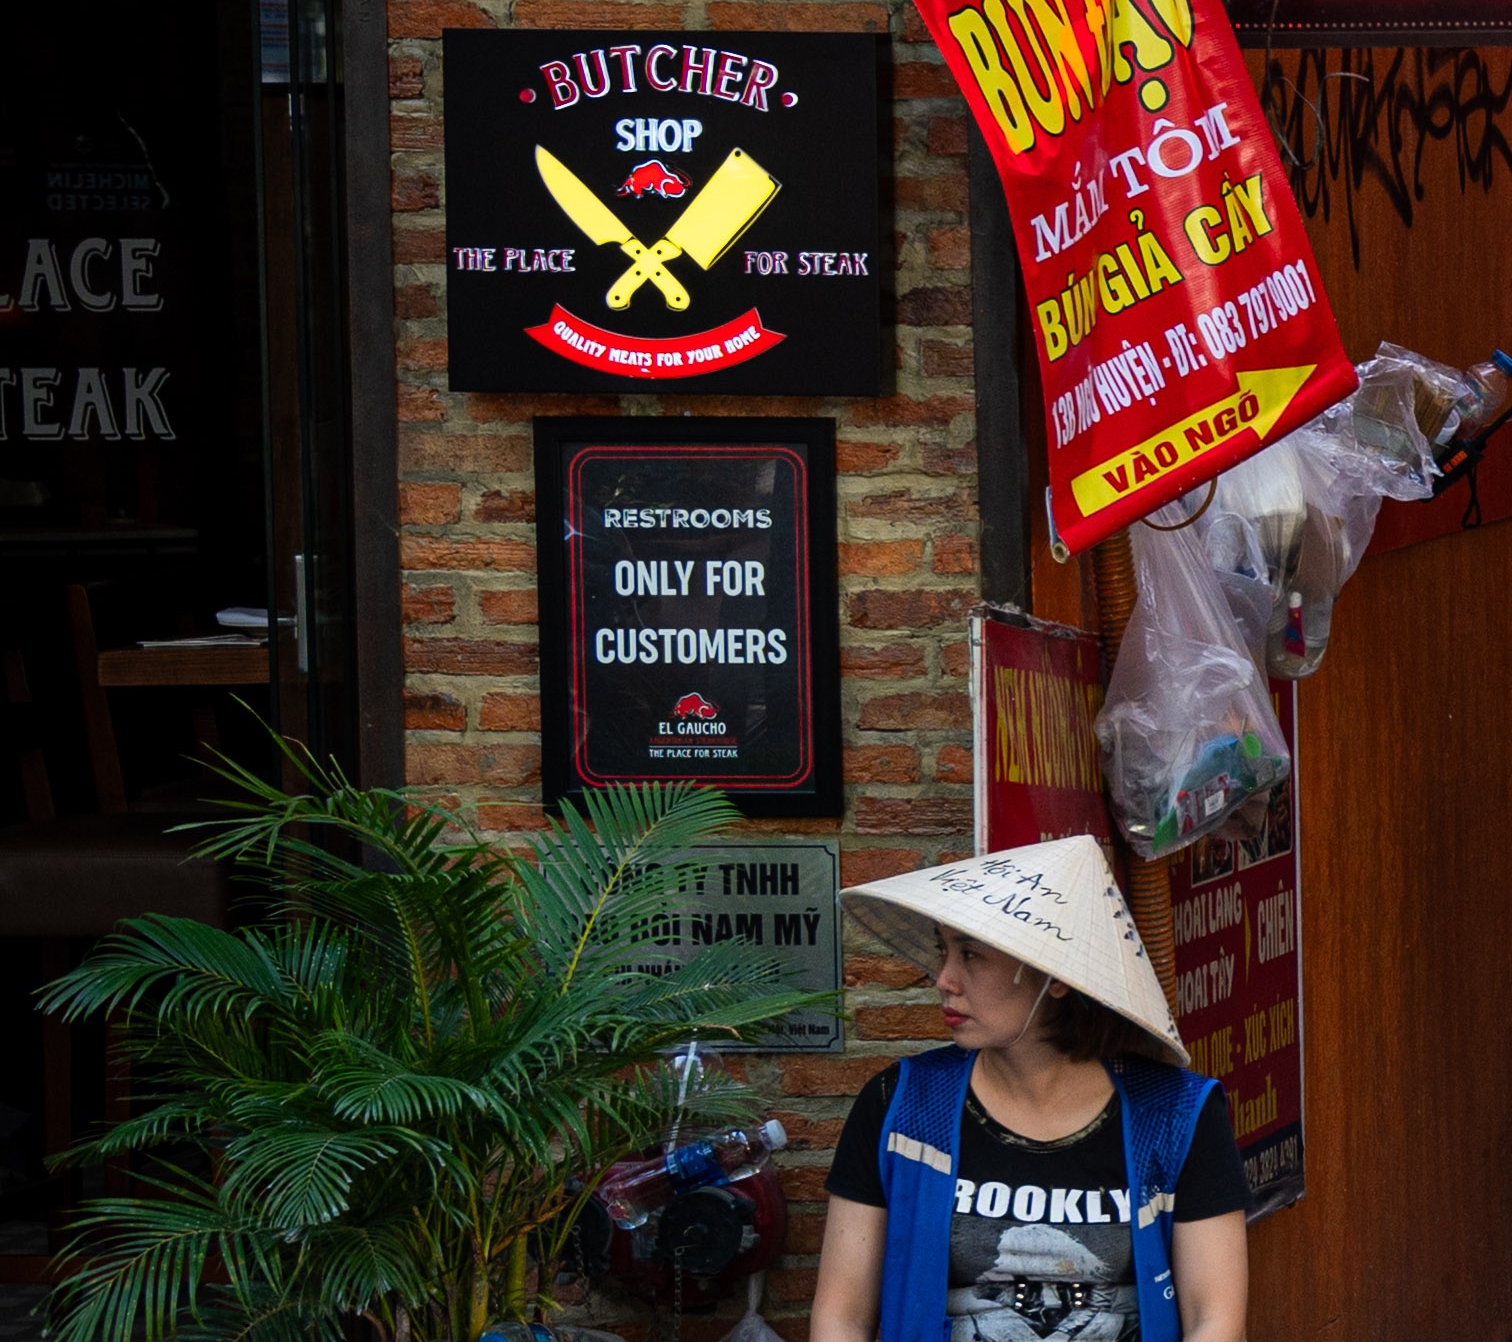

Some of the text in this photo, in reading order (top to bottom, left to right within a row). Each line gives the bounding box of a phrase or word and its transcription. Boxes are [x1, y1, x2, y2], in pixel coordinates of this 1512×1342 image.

[540, 44, 778, 112] BUTCHER
[616, 118, 703, 152] SHOP
[1110, 102, 1240, 199] TÔM
[453, 247, 576, 272] THE PLACE
[744, 251, 870, 276] FOR STEAK
[1036, 171, 1273, 362] BÚN GIẢ CẦY
[553, 321, 761, 367] QUALITY MEATS FOR YOUR HOME
[1052, 389, 1076, 449] 13B
[1093, 340, 1165, 415] HUYỆN
[1198, 301, 1248, 360] 083
[1102, 390, 1259, 493] VÀO NGÕ
[604, 509, 772, 528] RESTROOMS
[615, 560, 765, 596] ONLY FOR
[595, 628, 787, 664] CUSTOMERS
[659, 722, 726, 734] EL GAUCHO
[719, 863, 799, 895] TNHH
[980, 859, 1068, 905] Hội An
[692, 907, 820, 945] NAM MỸ
[929, 868, 1073, 942] Việt Nam
[1209, 880, 1294, 964] LANG CHIÊN
[1210, 945, 1235, 999] TÂY
[1245, 994, 1294, 1065] XÚC XÍCH
